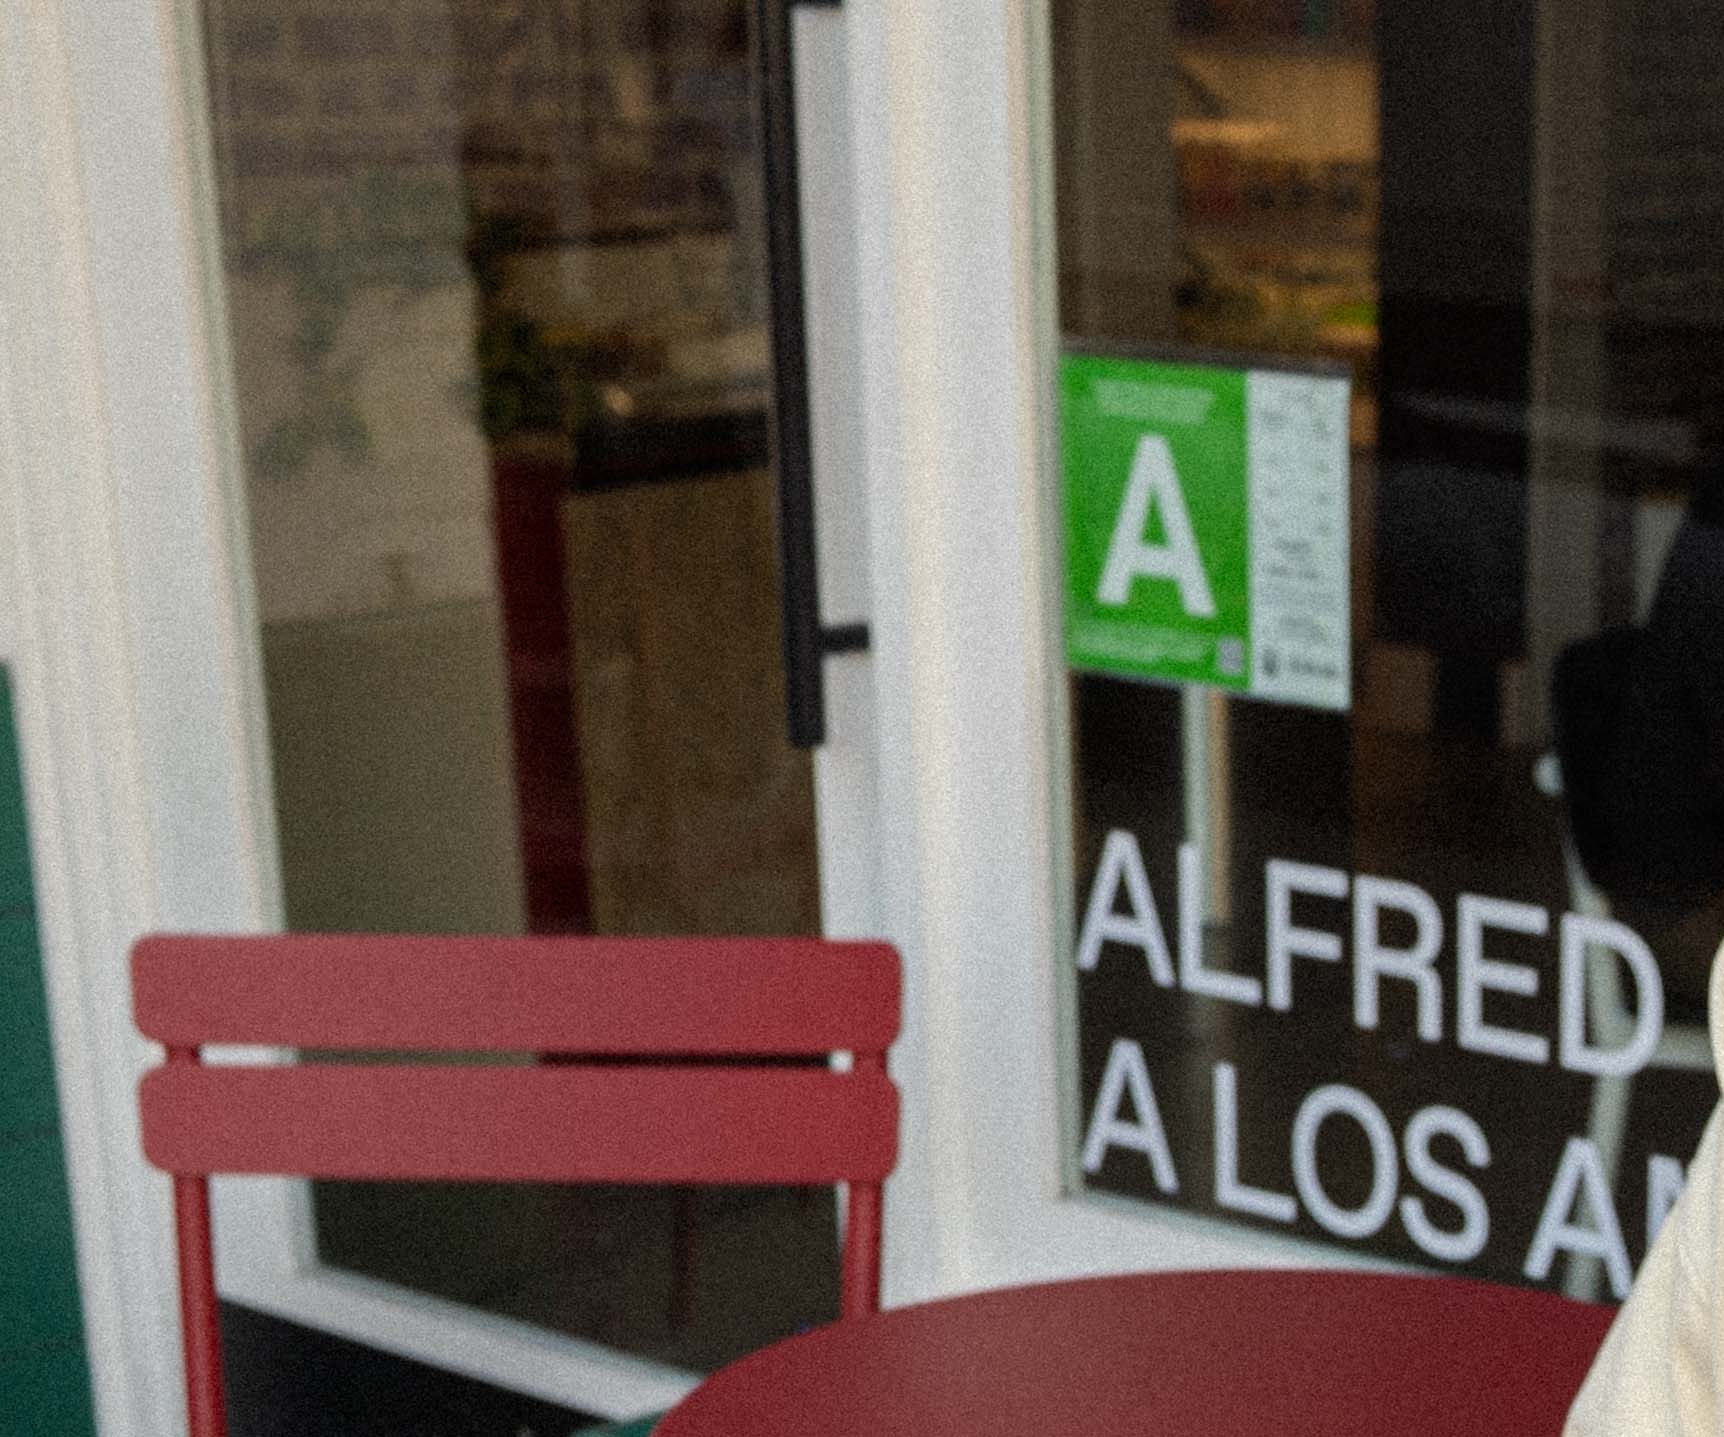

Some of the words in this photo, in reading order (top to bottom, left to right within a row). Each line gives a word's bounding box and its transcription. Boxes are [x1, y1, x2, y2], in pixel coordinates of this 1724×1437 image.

[1097, 433, 1217, 620] A
[1076, 828, 1664, 1079] ALFRED
[1082, 1039, 1181, 1195] A
[1213, 1062, 1492, 1264] LOS
